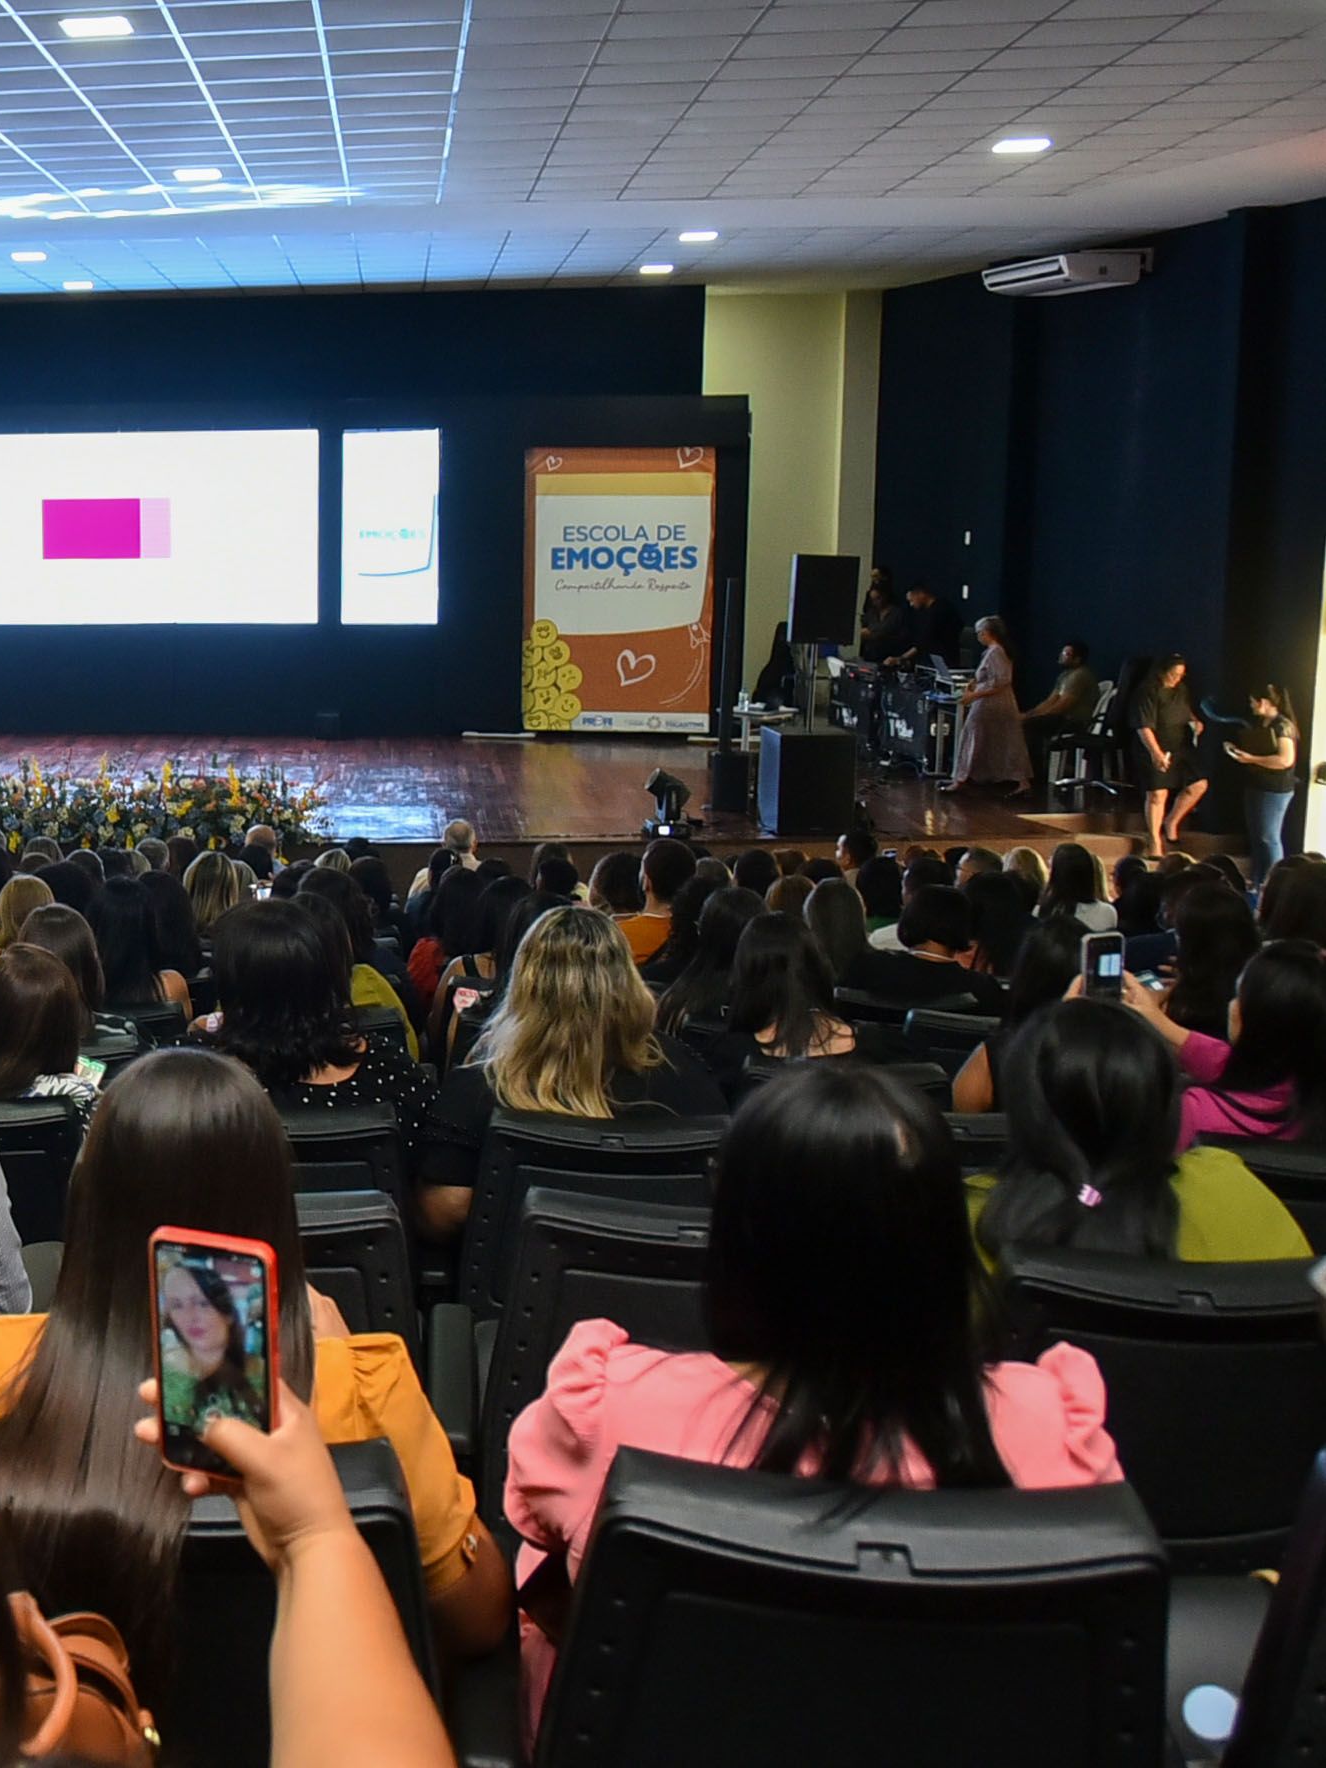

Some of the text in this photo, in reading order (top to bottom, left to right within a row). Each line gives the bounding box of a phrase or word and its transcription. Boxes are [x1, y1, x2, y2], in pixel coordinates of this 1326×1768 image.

[563, 525, 686, 542] ESCOLA DE
[551, 542, 698, 576] EMOÇÕES
[555, 578, 691, 592] Compartilhando Respeito
